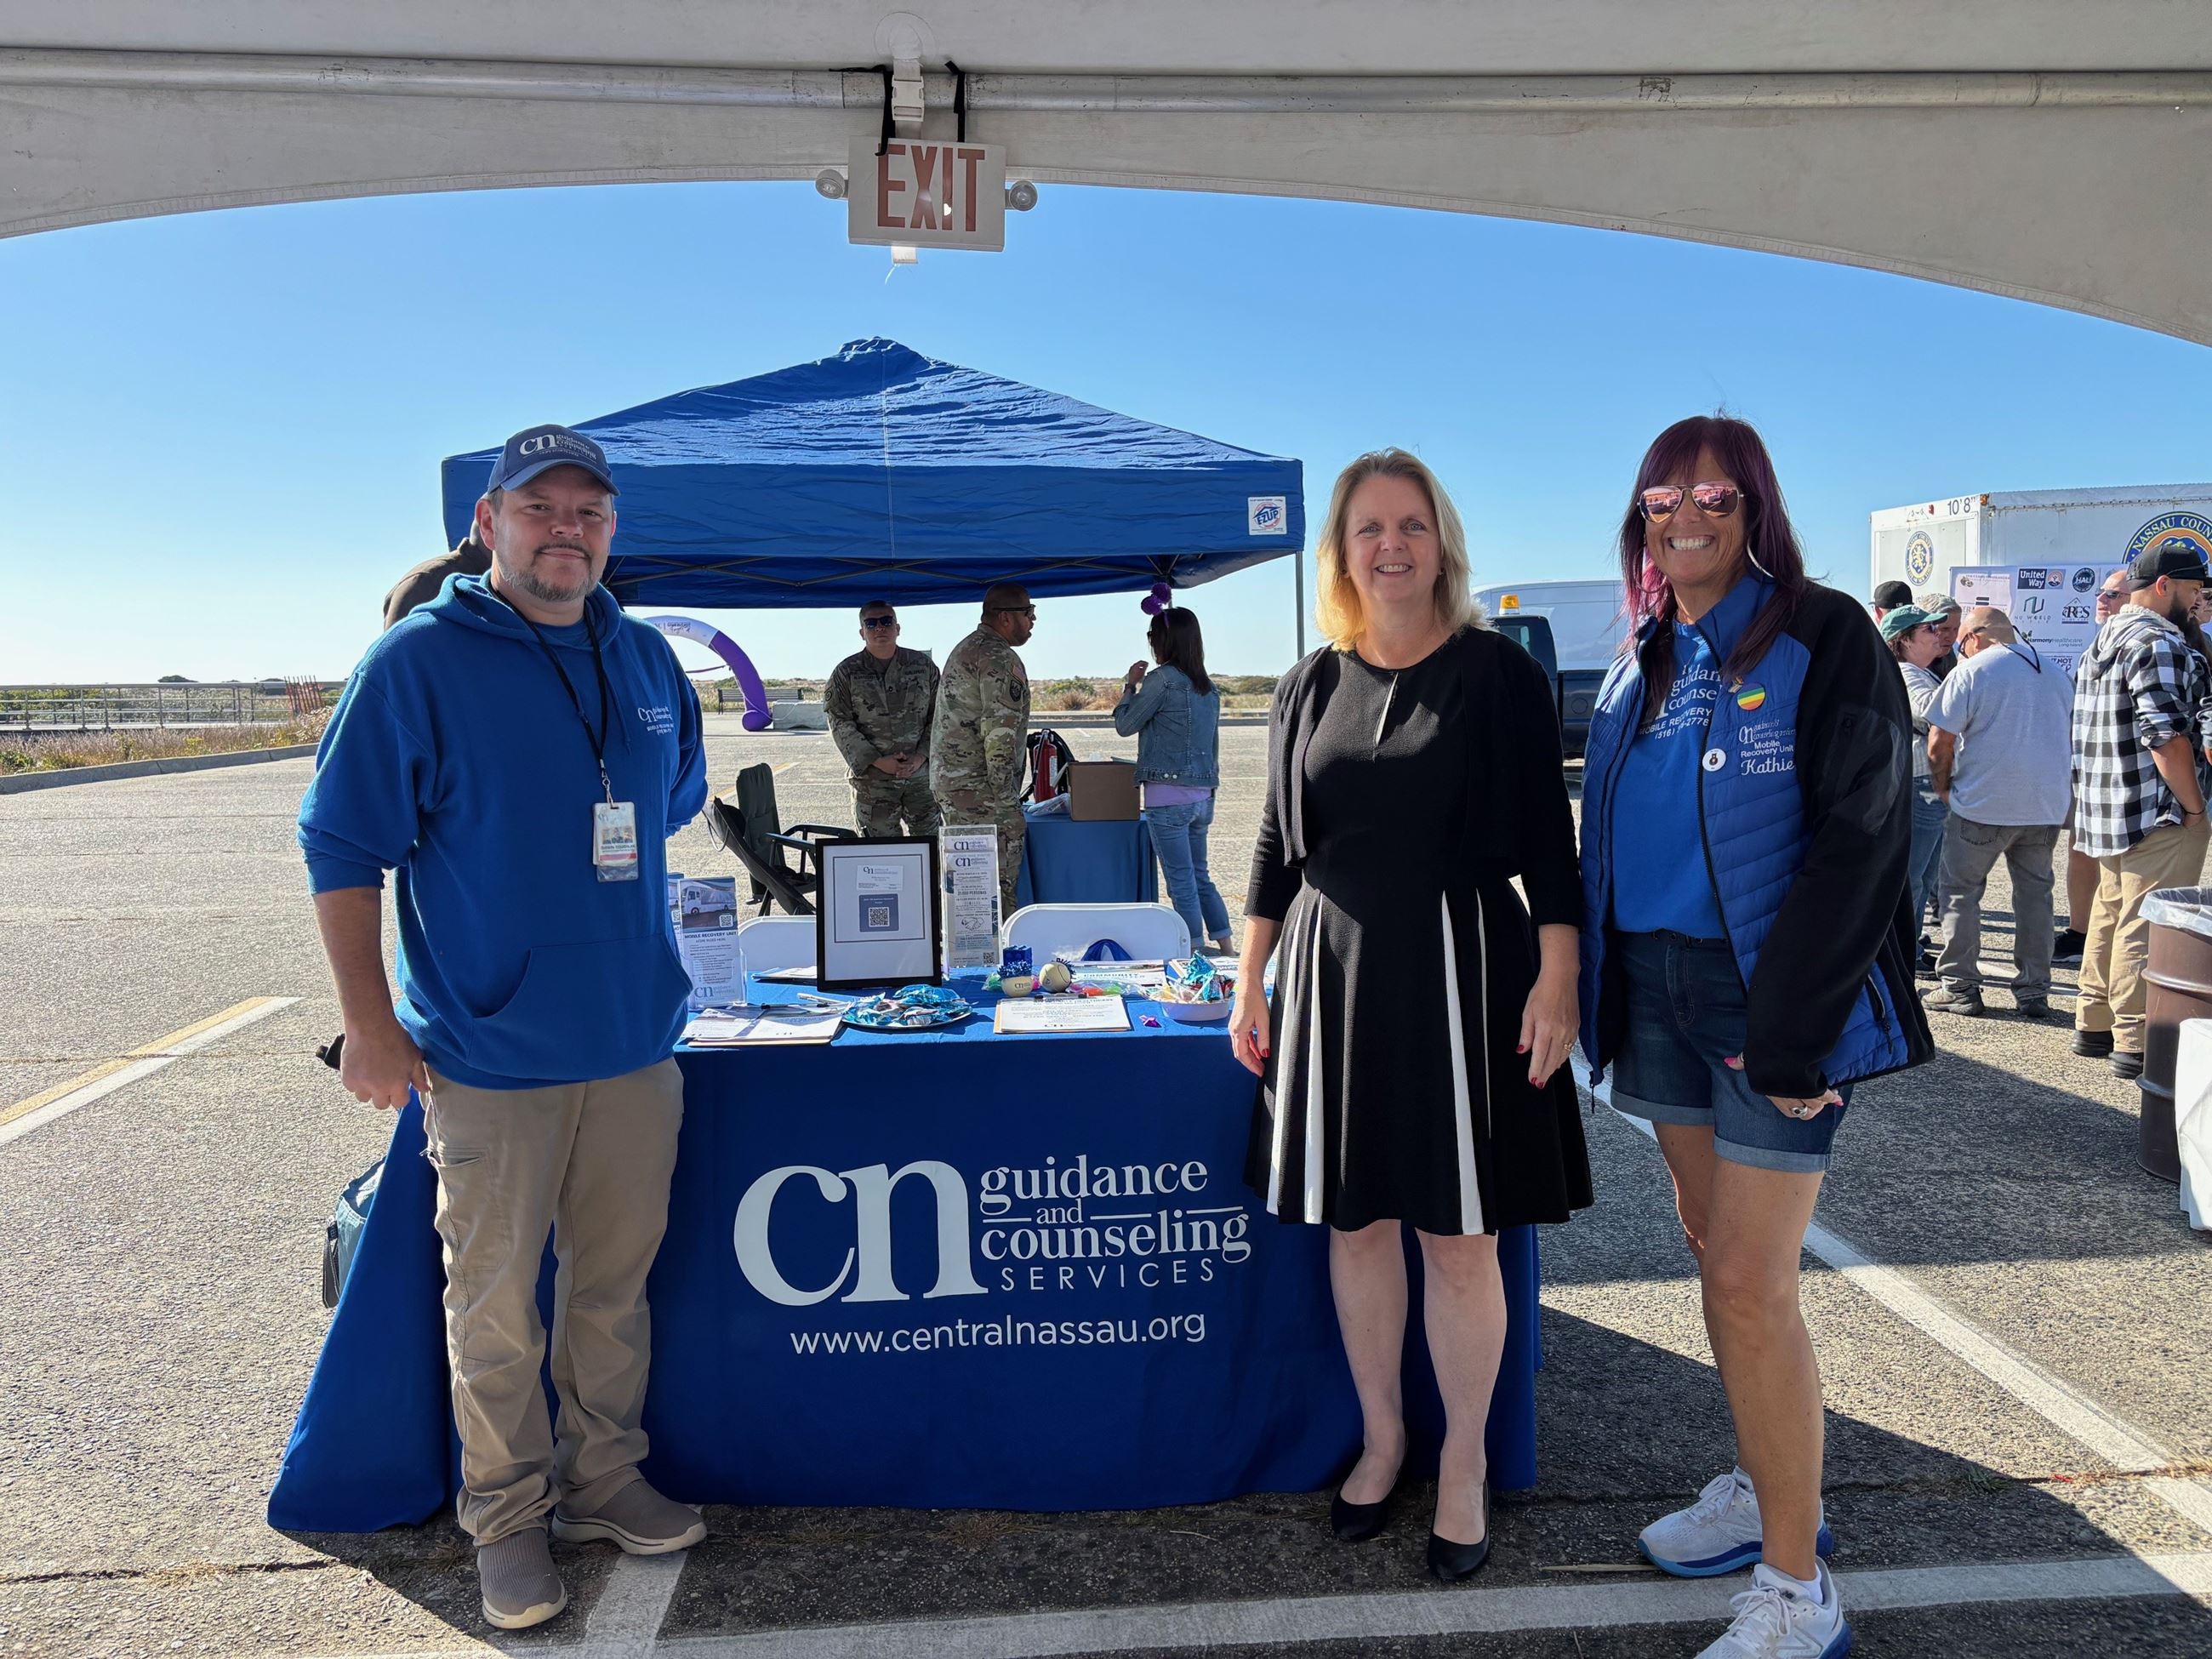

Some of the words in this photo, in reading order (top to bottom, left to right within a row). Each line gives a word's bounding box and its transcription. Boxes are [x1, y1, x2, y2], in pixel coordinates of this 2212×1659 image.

[877, 143, 985, 232] EXIT
[519, 434, 559, 455] cn
[2132, 516, 2175, 552] NASSAU
[2180, 516, 2212, 542] COUN
[2020, 570, 2045, 579] United
[2028, 579, 2044, 589] Way
[1741, 747, 1778, 759] Recovery
[1779, 744, 1794, 753] Unit
[1754, 739, 1781, 750] Mobile
[1741, 756, 1795, 776] Kathie
[954, 841, 969, 851] cn
[955, 857, 971, 867] cn
[694, 986, 715, 998] cn
[980, 1154, 1208, 1215] guidance
[1036, 1199, 1083, 1224] and
[733, 1160, 989, 1306] cn
[980, 1208, 1251, 1263] counseling
[1001, 1257, 1215, 1291] SERVICES
[790, 1313, 1206, 1354] www.centralnassau.org
